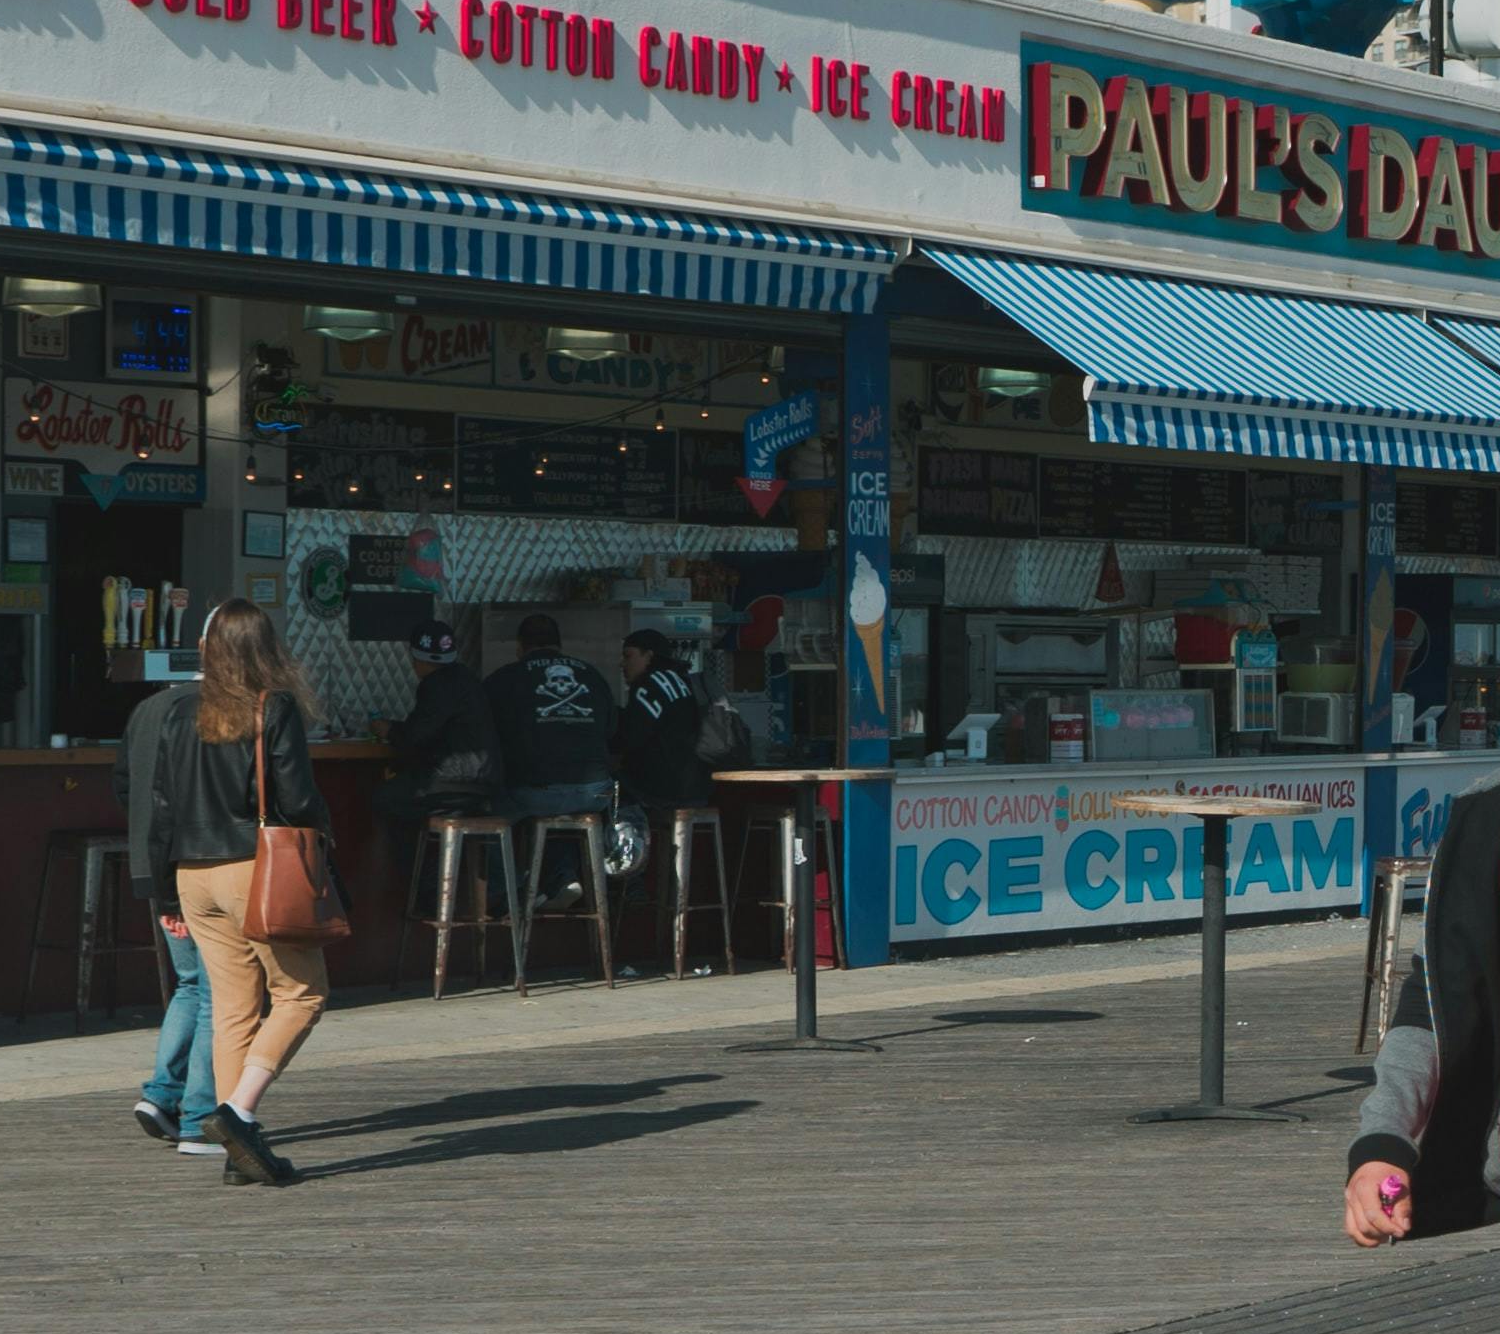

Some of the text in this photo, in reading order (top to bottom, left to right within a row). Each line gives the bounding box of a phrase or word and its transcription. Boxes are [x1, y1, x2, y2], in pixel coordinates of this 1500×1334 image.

[638, 26, 765, 104] CANDY
[811, 55, 871, 122] ICE
[891, 70, 1006, 143] CREAM
[1030, 61, 1343, 233] PAUL'S
[402, 315, 490, 375] CREAM
[548, 353, 677, 398] CANDY
[16, 385, 191, 454] Lobster Rolls
[750, 410, 788, 443] Lobster
[850, 404, 883, 445] Soft
[8, 467, 59, 492] WINE
[125, 472, 197, 494] OYSTERS
[749, 480, 773, 492] HERE
[851, 472, 887, 496] ICE
[847, 499, 890, 537] CREAM
[1369, 503, 1396, 523] ICE
[359, 550, 390, 563] COLD
[373, 538, 408, 549] NITR
[366, 565, 398, 578] COFF
[891, 567, 916, 585] epsi
[896, 794, 977, 832] COTTON
[984, 791, 1056, 826] CANDY
[1328, 779, 1356, 809] ICES
[895, 817, 1355, 927] ICE CREAM
